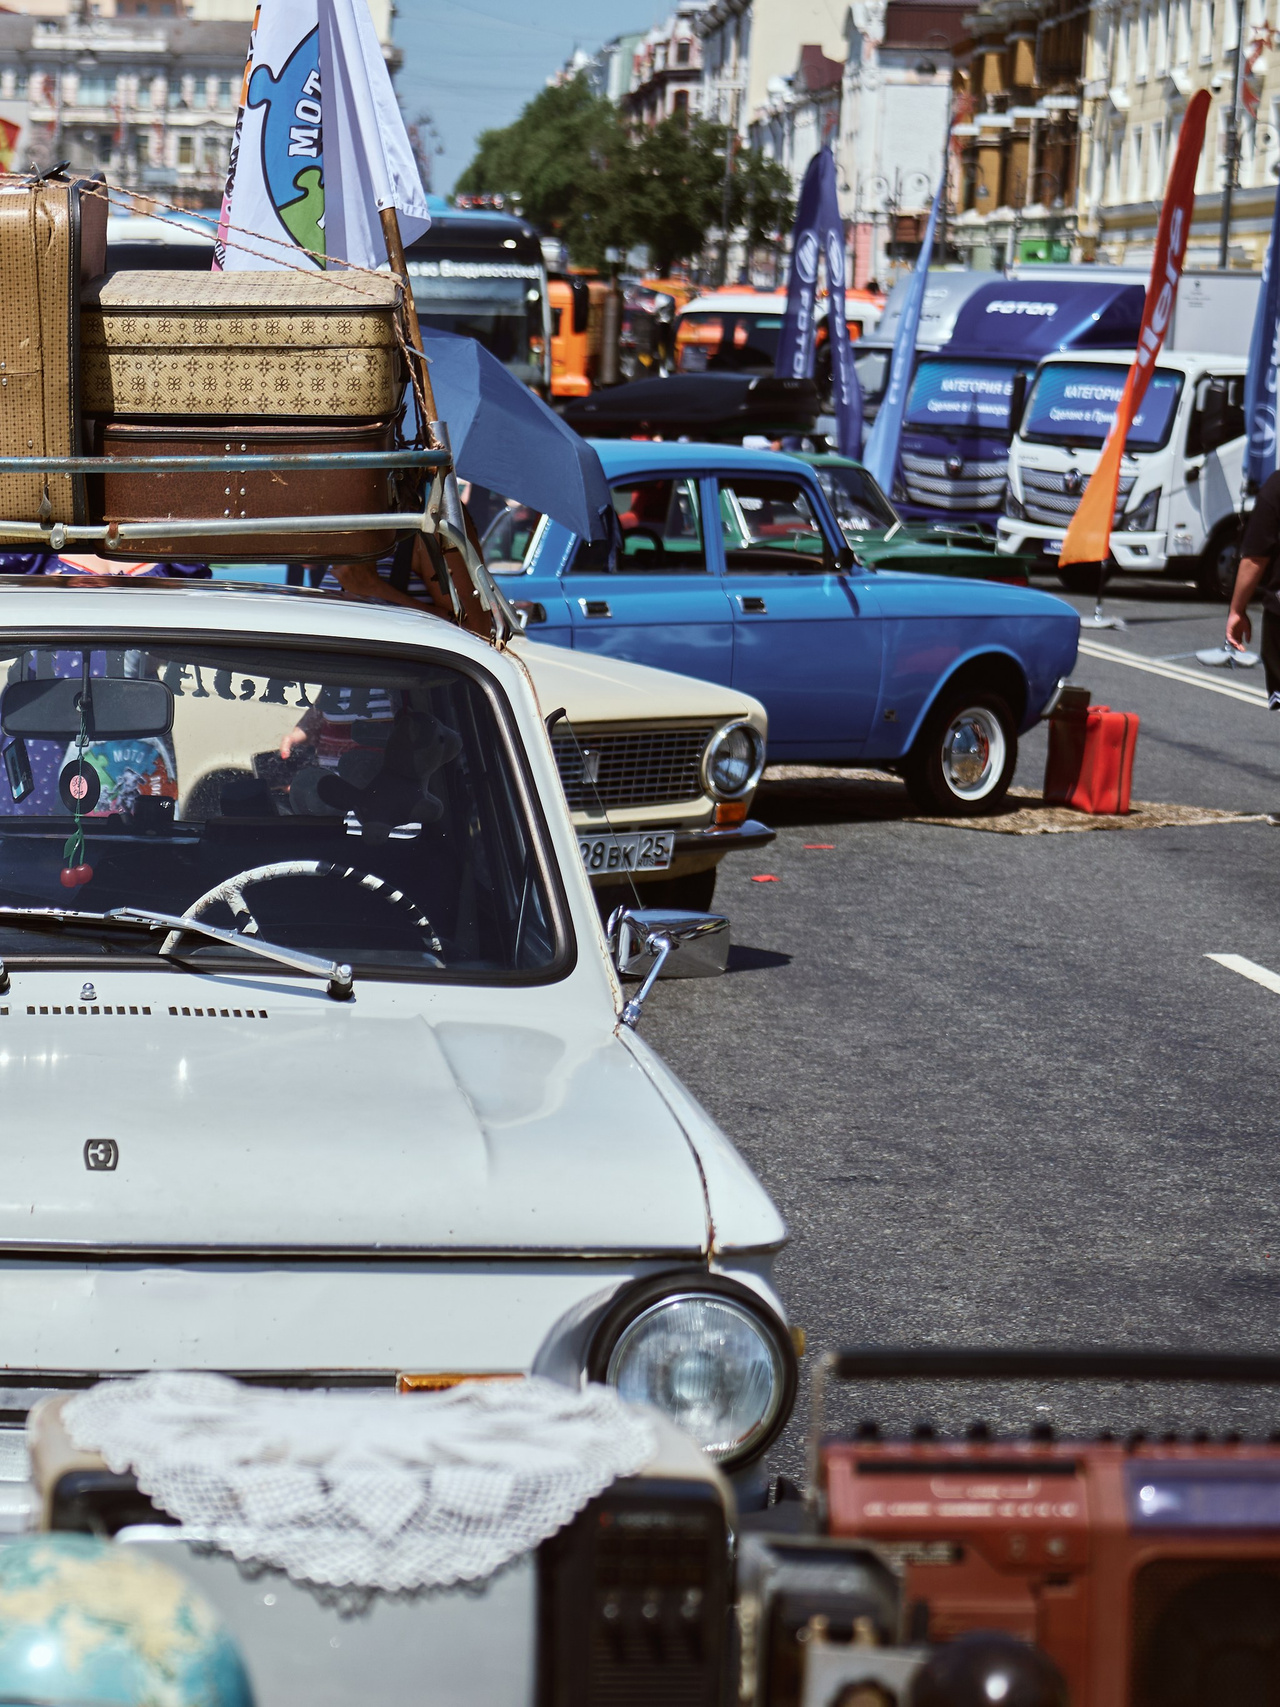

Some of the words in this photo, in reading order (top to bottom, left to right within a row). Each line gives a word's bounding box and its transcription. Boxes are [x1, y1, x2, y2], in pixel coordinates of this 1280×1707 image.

[986, 301, 1058, 316] FOTON
[1064, 385, 1123, 402] КАТЕГОРИ
[641, 836, 665, 857] 25
[637, 858, 655, 867] RUS
